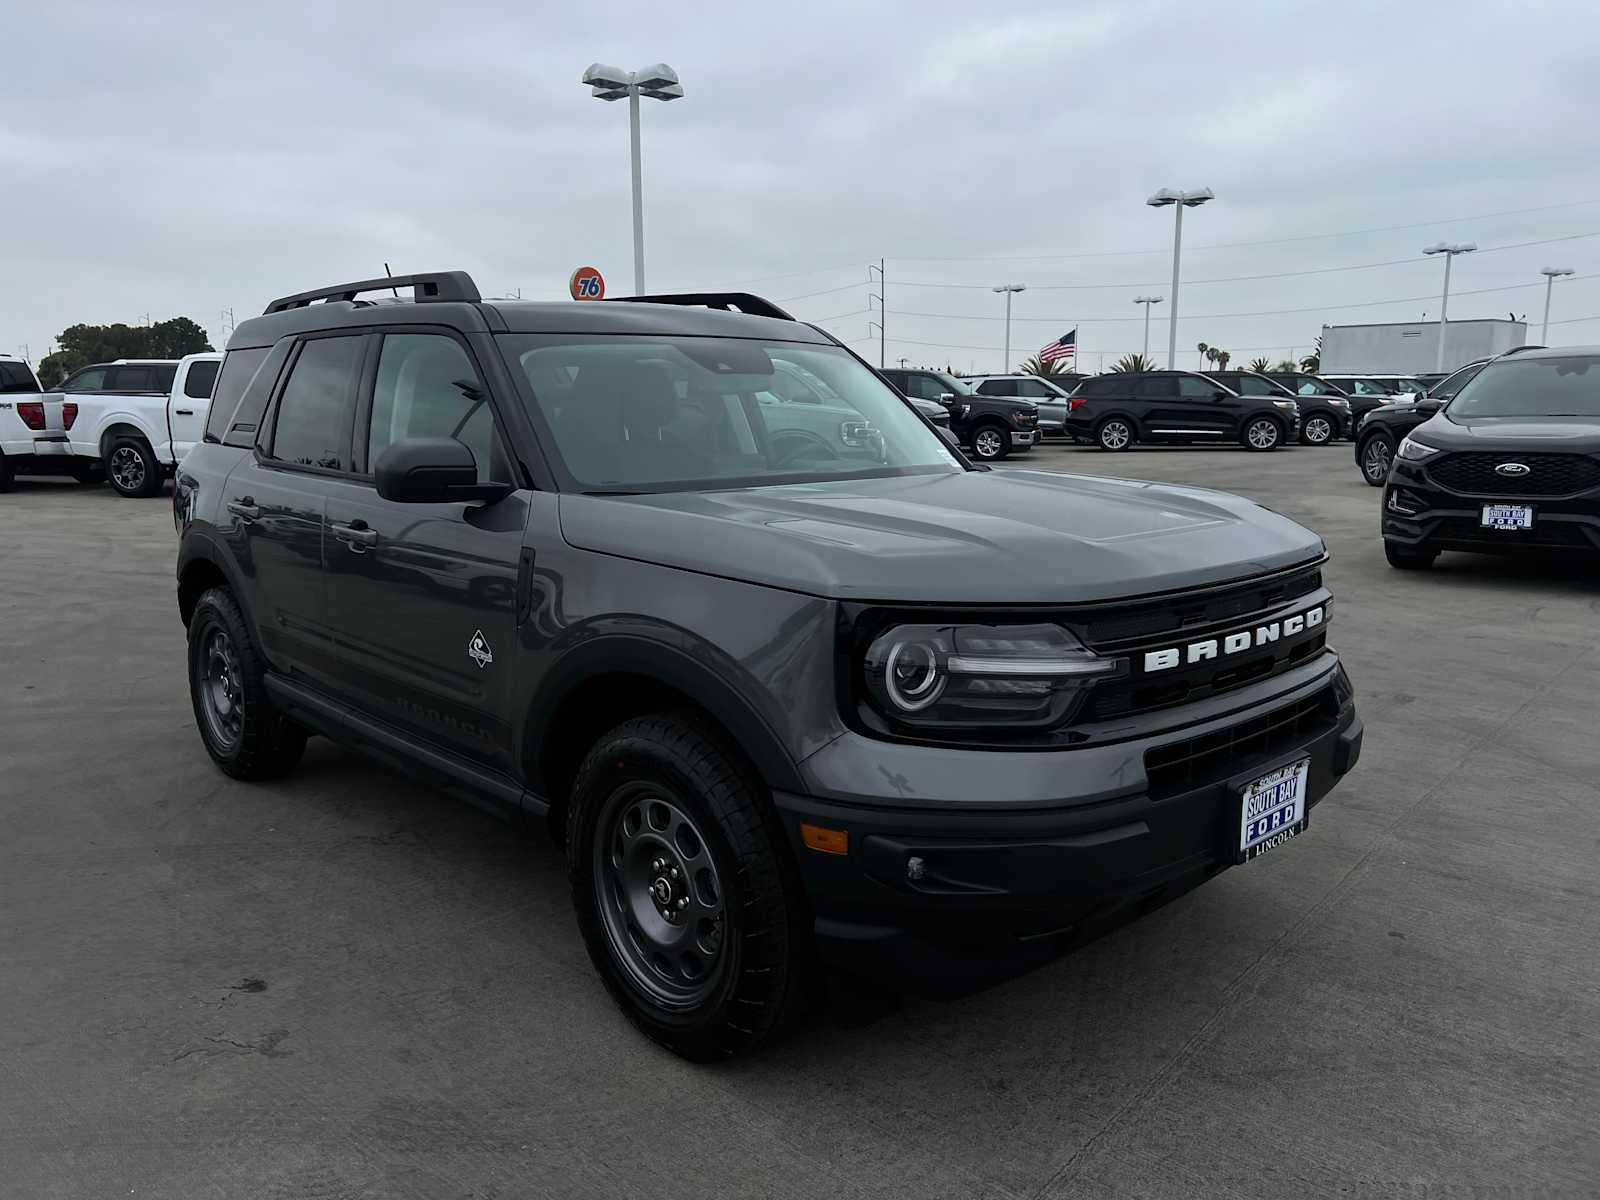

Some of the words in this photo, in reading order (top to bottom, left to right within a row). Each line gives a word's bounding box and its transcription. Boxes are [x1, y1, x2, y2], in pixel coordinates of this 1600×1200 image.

[578, 276, 600, 297] 76
[1489, 510, 1511, 518] SOUTH
[1490, 518, 1524, 526] FORD
[1144, 607, 1323, 673] BRONCO
[1248, 787, 1277, 818] SOUTH
[1279, 778, 1297, 803] BAY
[1247, 804, 1294, 843] FORD
[1256, 826, 1296, 856] LINCOLN
